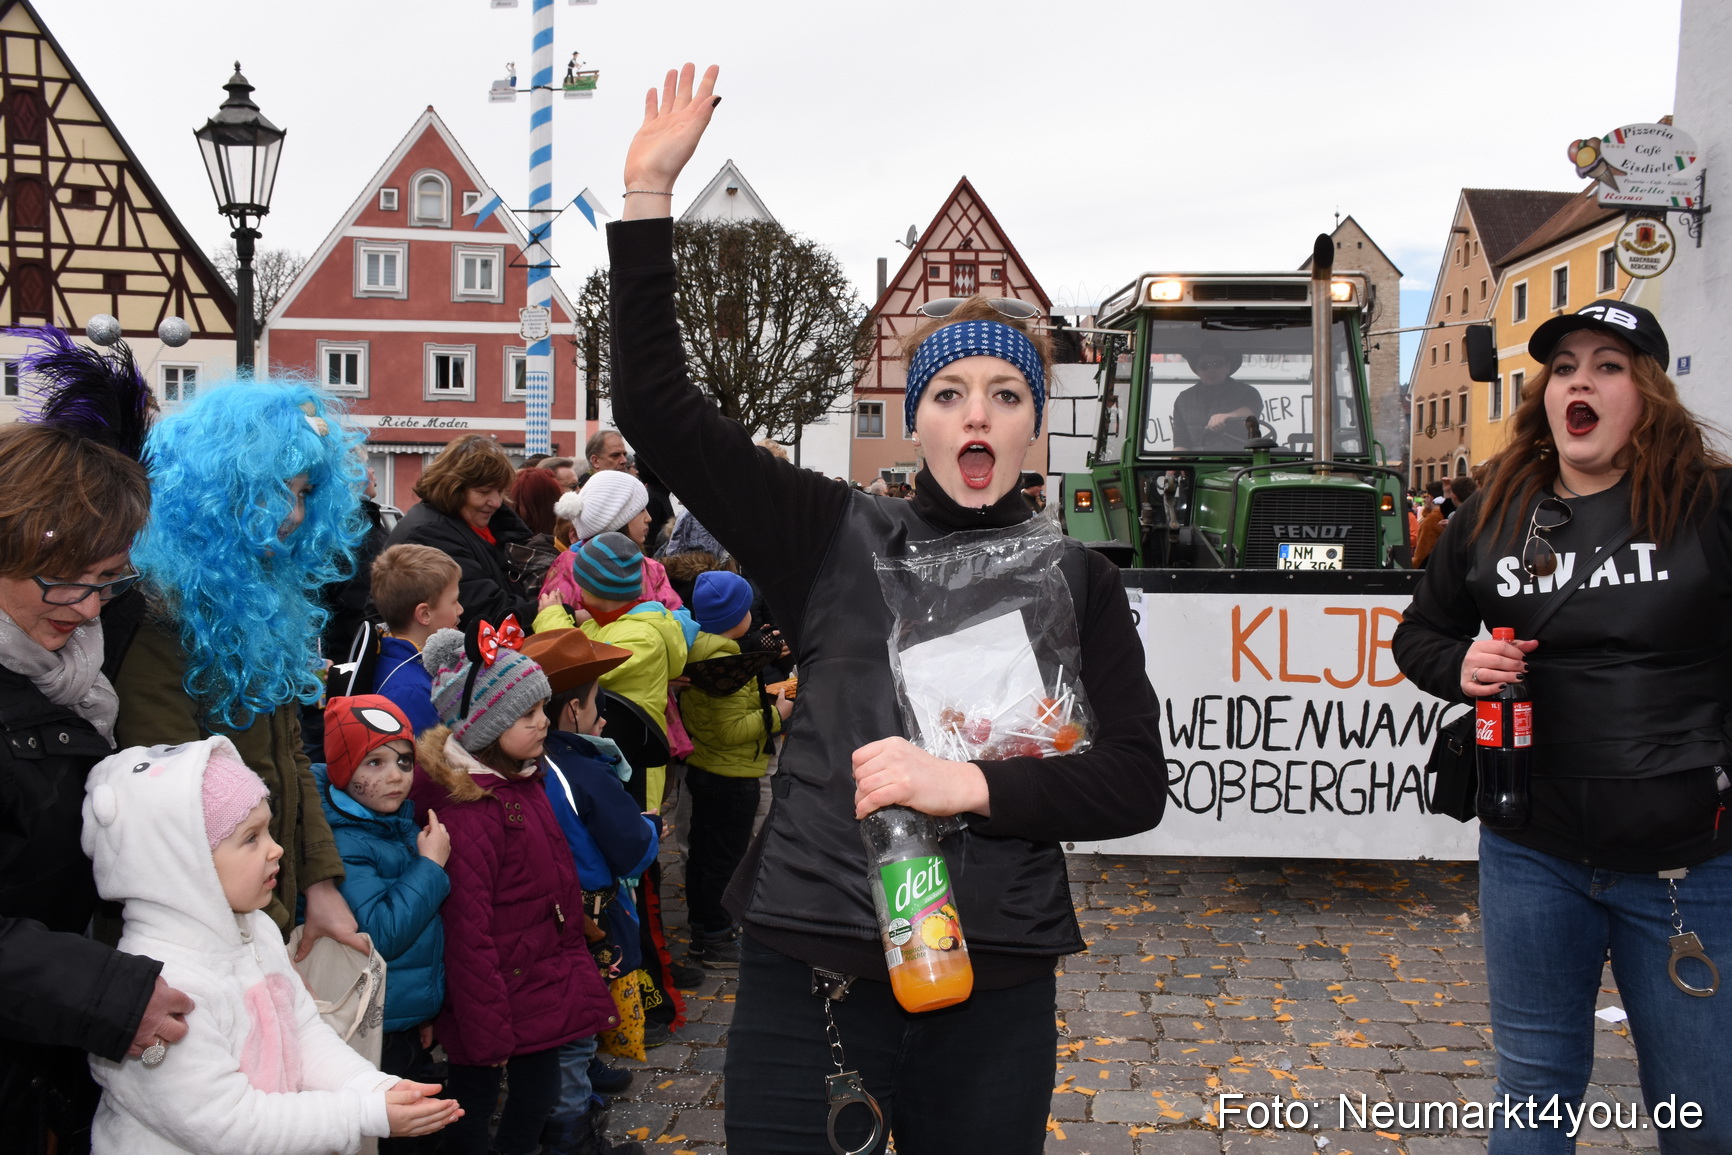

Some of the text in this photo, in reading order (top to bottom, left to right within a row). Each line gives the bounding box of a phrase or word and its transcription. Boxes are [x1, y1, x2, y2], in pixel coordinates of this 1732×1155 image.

[1623, 126, 1674, 140] Pizzeria
[1635, 144, 1662, 157] Café
[1620, 158, 1674, 174] Eisdiele
[1604, 192, 1643, 201] Roma
[1628, 185, 1665, 195] Bella
[378, 415, 469, 429] Riebe Moden
[1273, 525, 1353, 539] FENDT
[1294, 547, 1313, 560] NM
[1232, 604, 1405, 689] KLJB
[895, 857, 944, 913] deit
[645, 989, 663, 1010] AS
